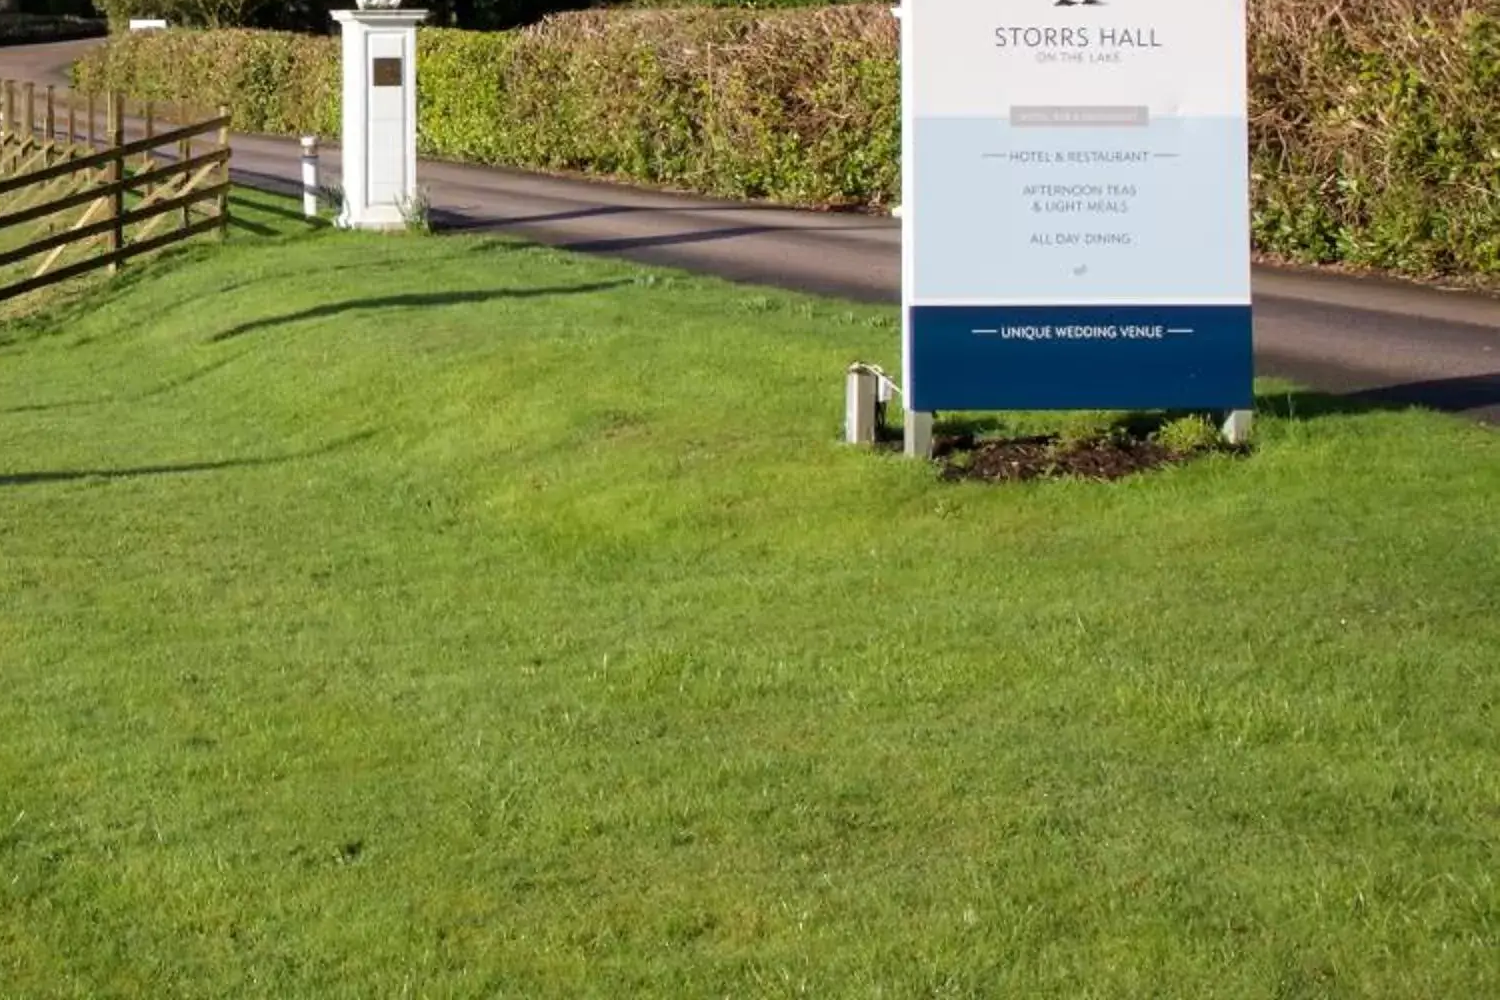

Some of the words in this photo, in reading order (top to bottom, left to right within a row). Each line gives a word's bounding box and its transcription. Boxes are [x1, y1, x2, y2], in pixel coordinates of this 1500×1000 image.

[995, 27, 1089, 47] STORRS
[1100, 27, 1162, 47] HALL
[1036, 52, 1056, 63] ON
[1061, 52, 1083, 63] THE
[1090, 52, 1120, 63] LAKE
[1009, 151, 1051, 163] HOTEL
[1054, 151, 1064, 163] &
[1067, 151, 1149, 163] RESTAURANT
[1023, 184, 1102, 196] AFTERNOON
[1107, 184, 1136, 196] TEAS
[1031, 201, 1041, 213] &
[1045, 201, 1083, 213] LIGHT
[1087, 201, 1128, 213] MEALS
[1030, 233, 1051, 245] ALL
[1055, 233, 1079, 245] DAY
[1085, 233, 1131, 245] DINING
[1001, 326, 1052, 340] UNIQUE
[1055, 326, 1117, 339] WEDDING
[1119, 326, 1163, 338] VENUE
